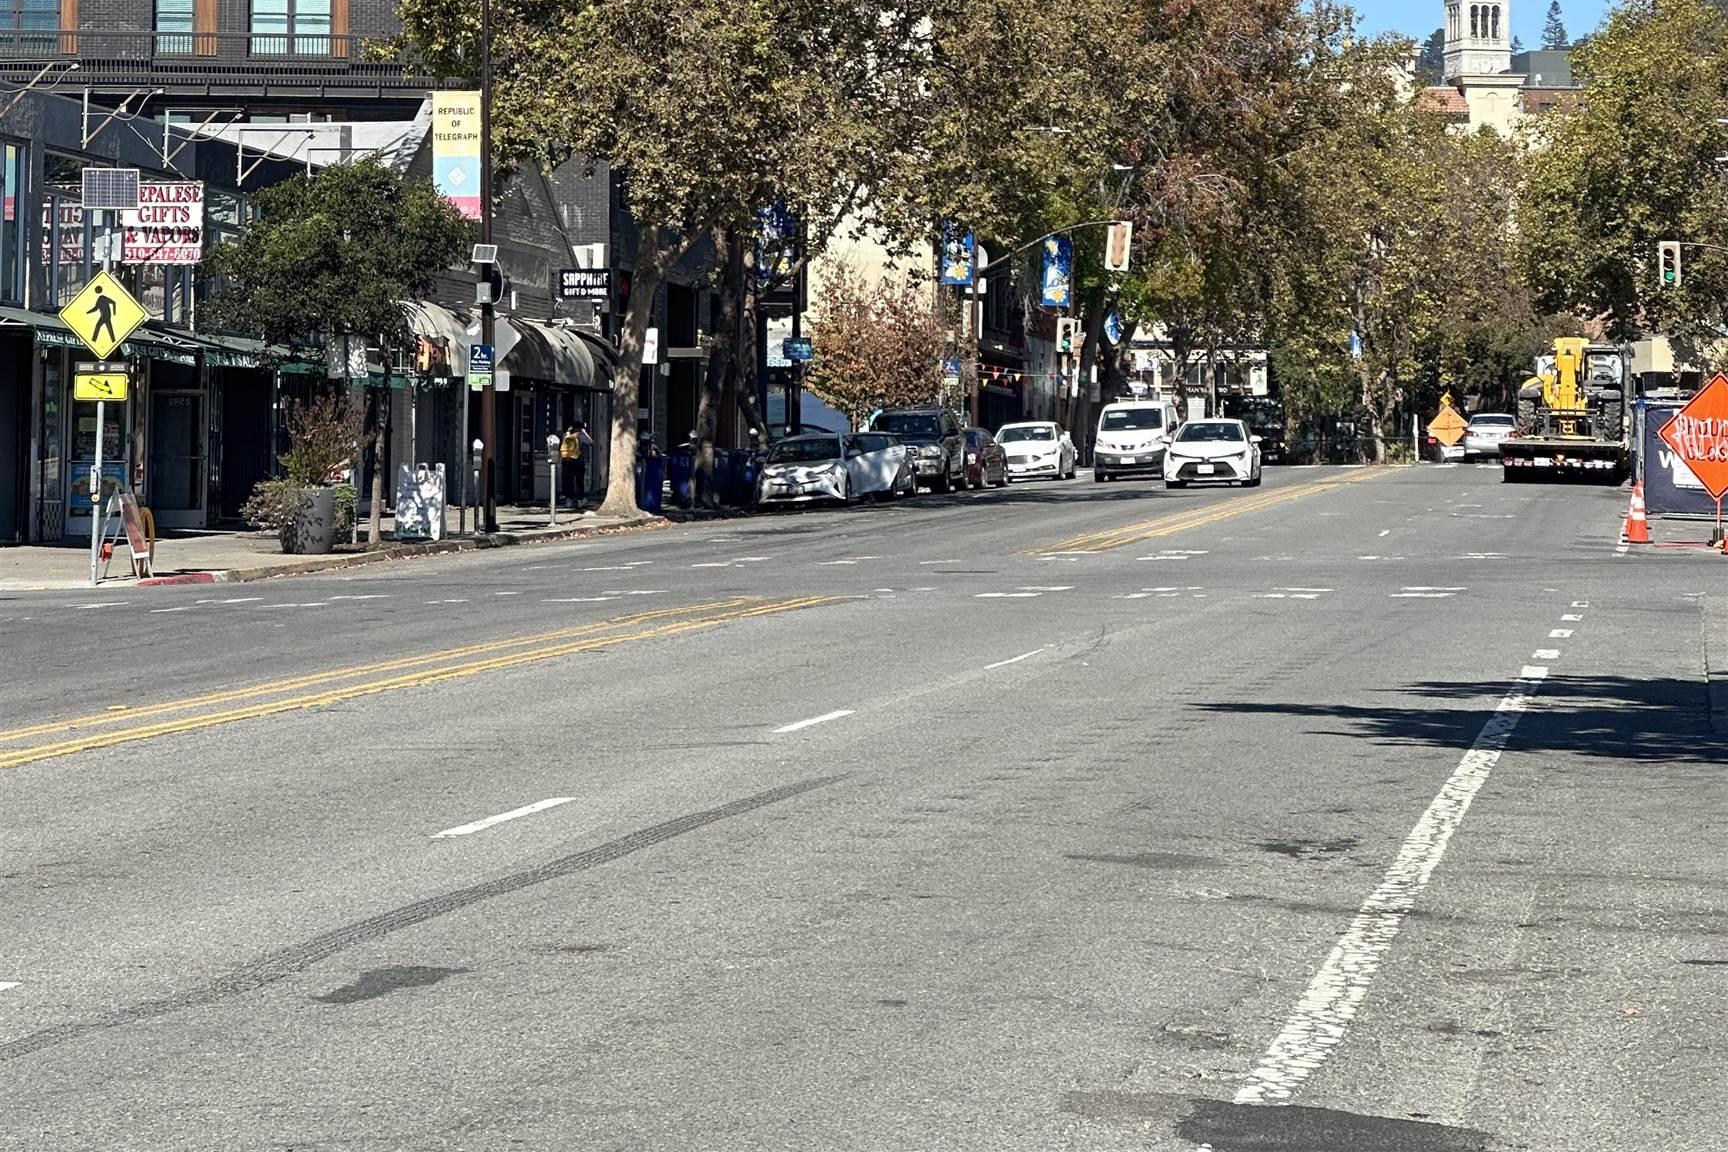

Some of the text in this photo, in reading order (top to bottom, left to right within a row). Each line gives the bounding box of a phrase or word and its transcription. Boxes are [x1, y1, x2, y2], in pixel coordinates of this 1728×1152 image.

[438, 107, 475, 115] REPUBLIC
[139, 186, 200, 202] EPALESE
[137, 206, 190, 222] GIFTS
[127, 227, 200, 243] & VAPORS
[563, 273, 608, 285] SAPPHIRE
